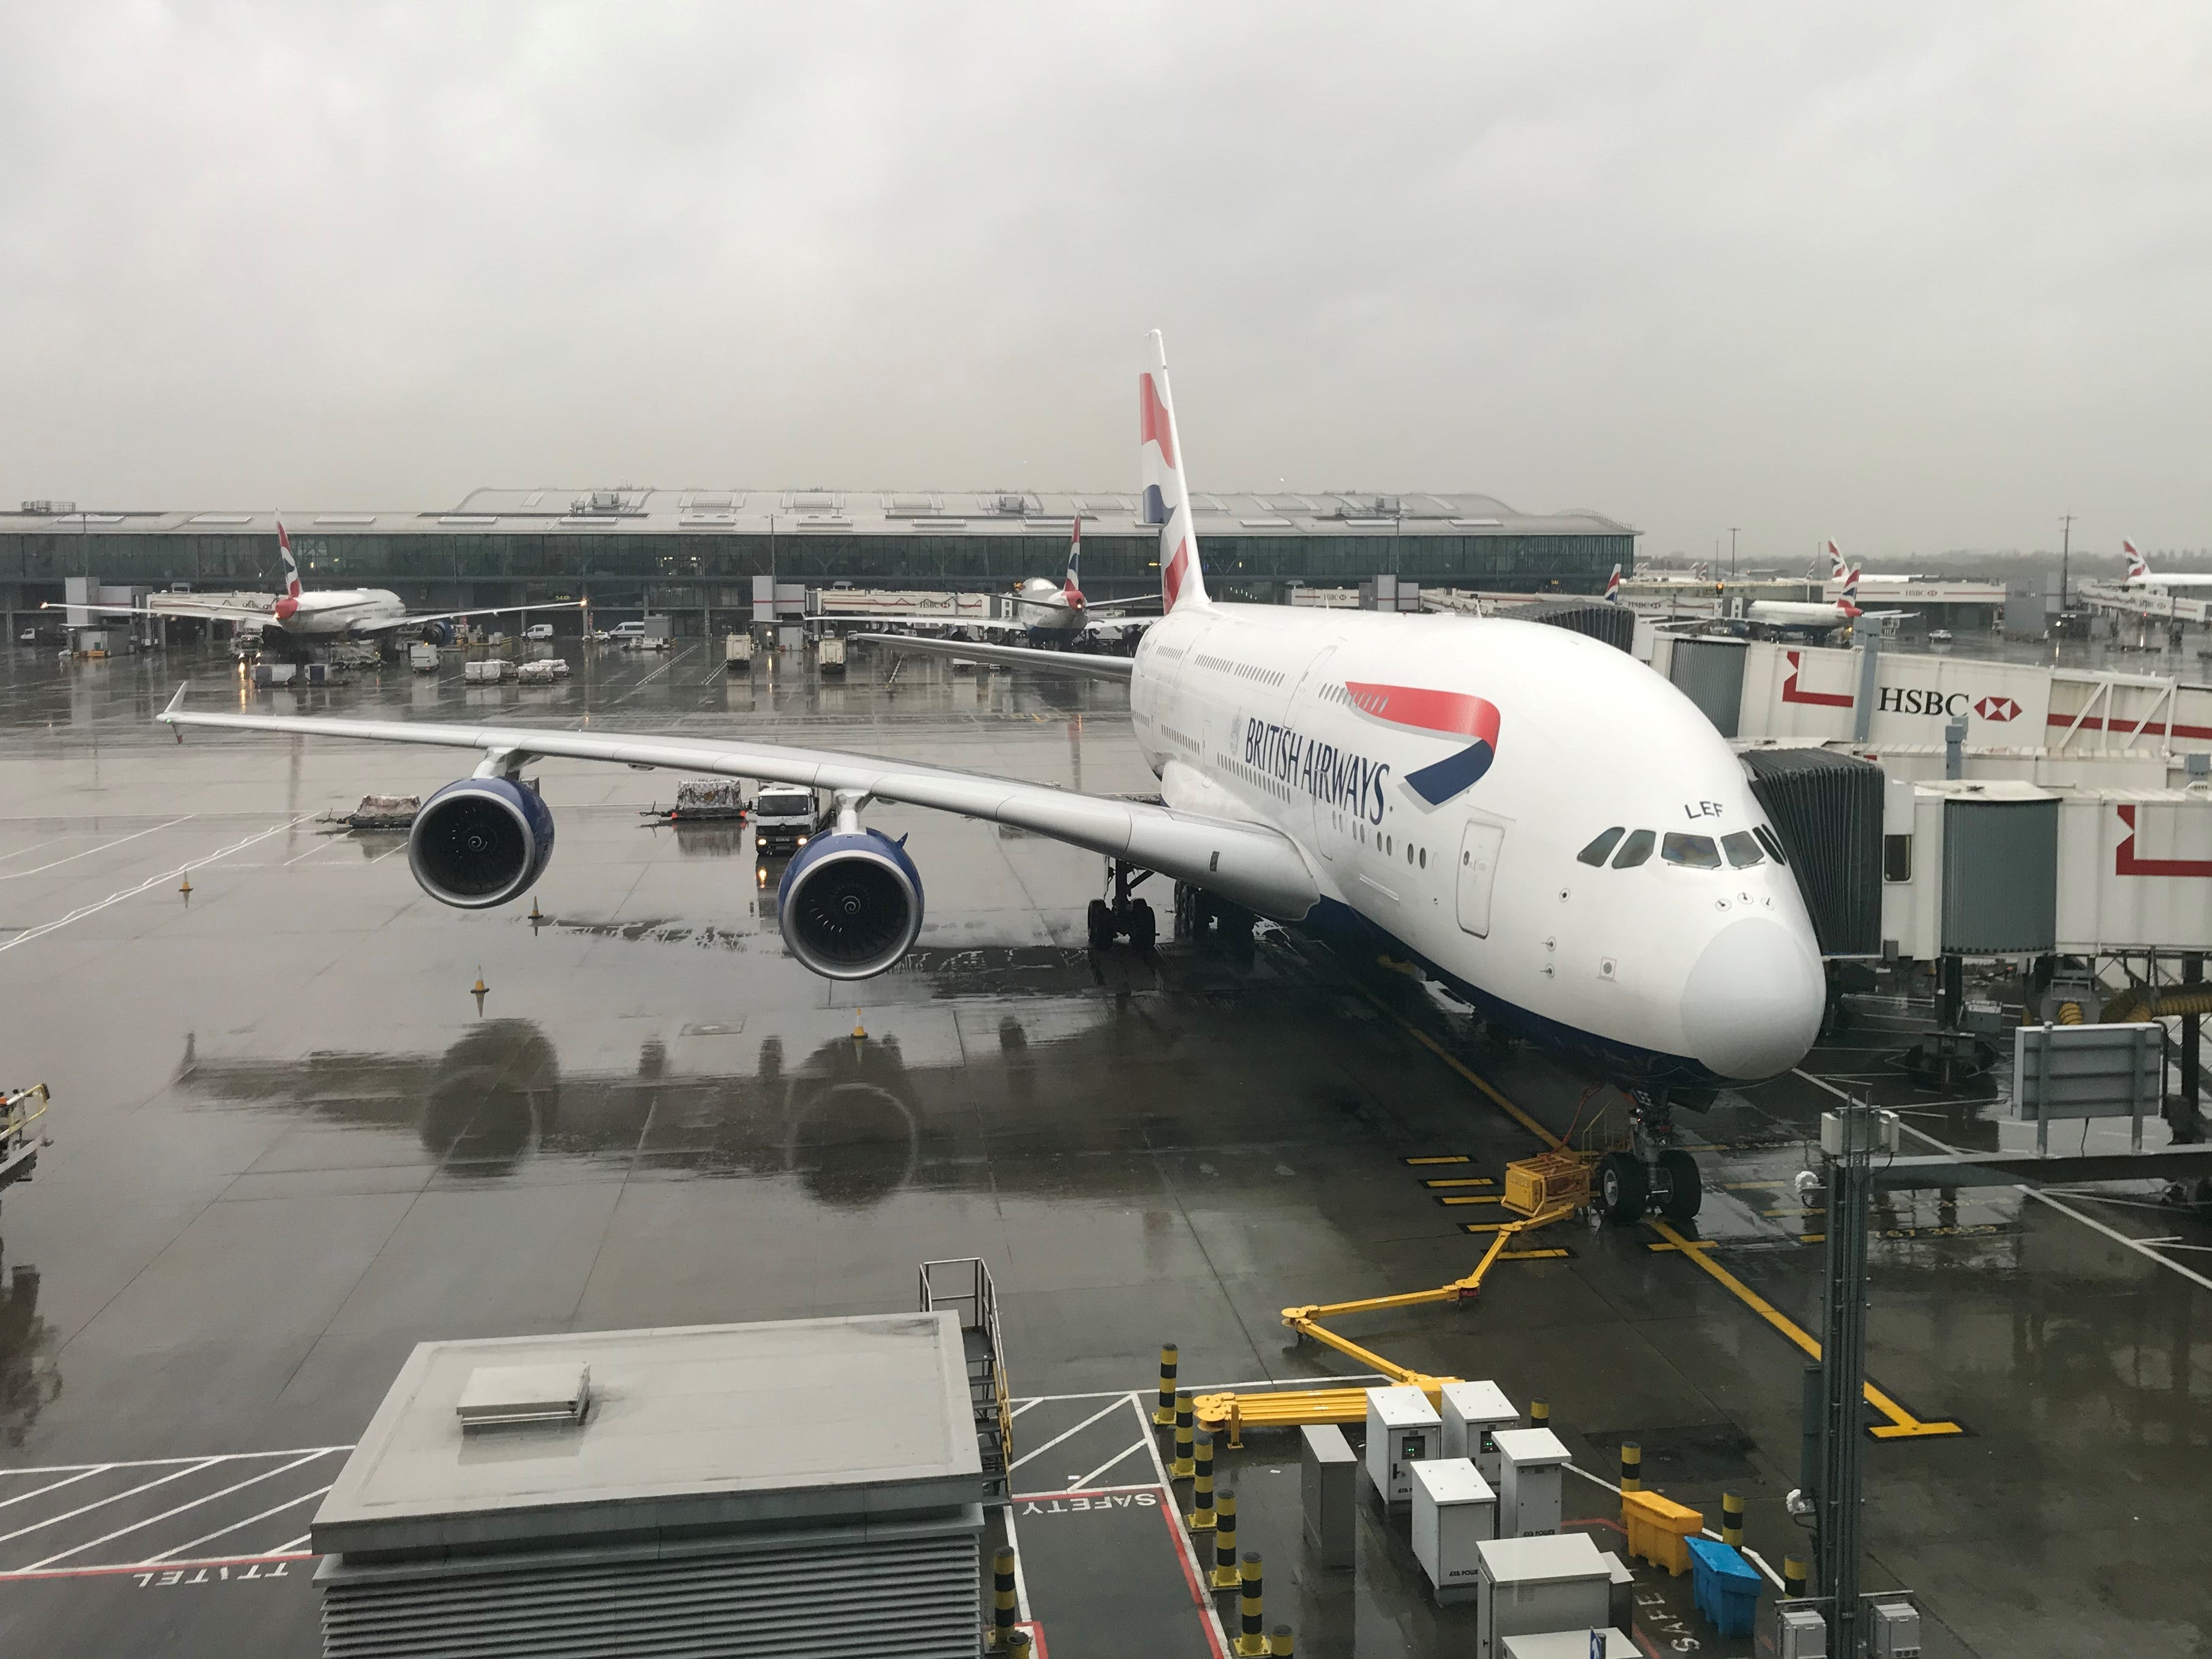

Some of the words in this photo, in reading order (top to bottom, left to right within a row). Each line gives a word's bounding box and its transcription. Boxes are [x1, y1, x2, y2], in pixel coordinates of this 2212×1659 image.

[1877, 686, 1969, 717] HSBC
[1245, 717, 1303, 788] BRITISH
[1301, 740, 1391, 826] AIRWAYS
[1684, 801, 1723, 819] LEF
[1022, 1493, 1157, 1515] SAFETY
